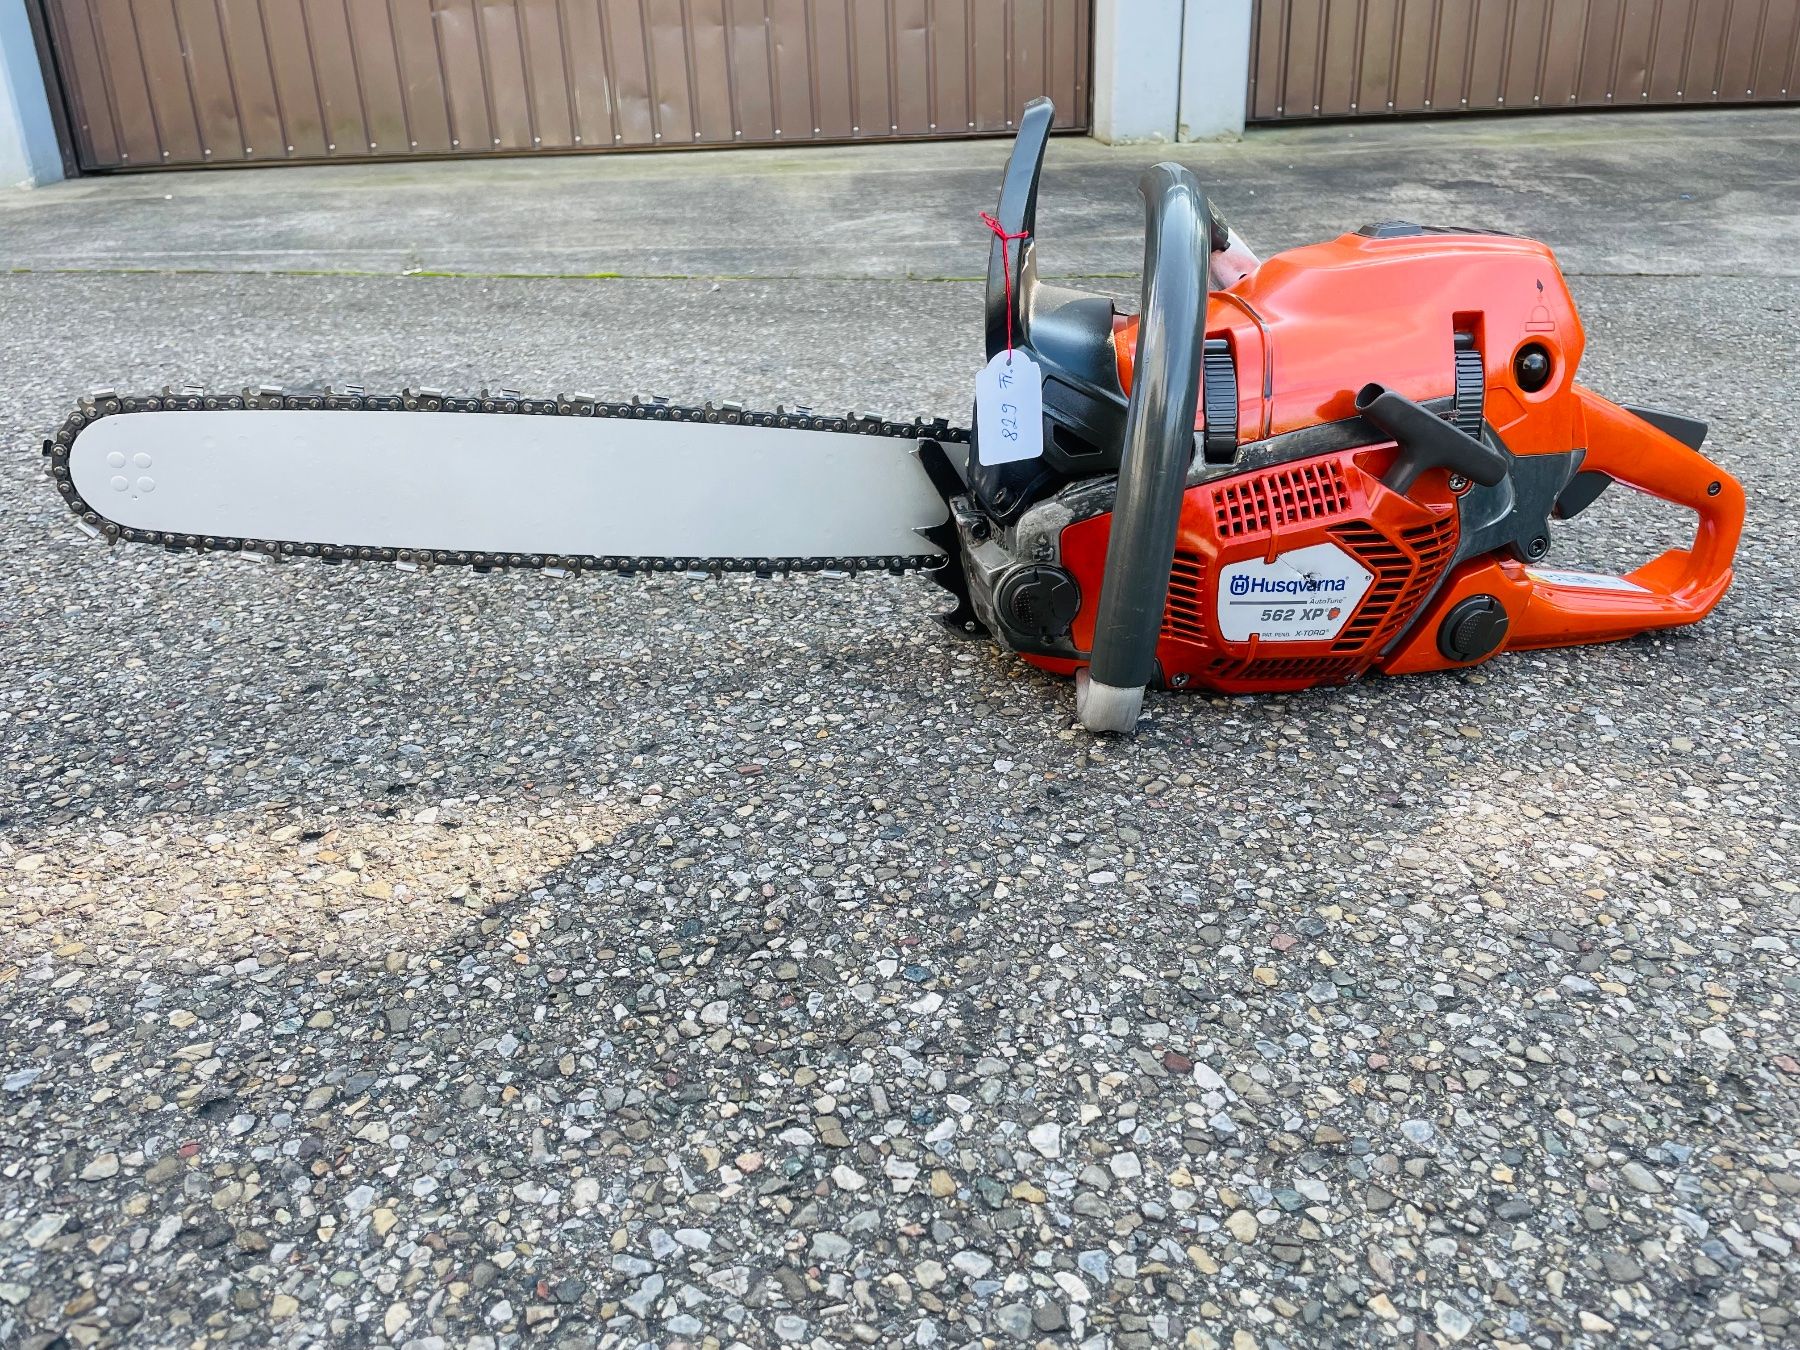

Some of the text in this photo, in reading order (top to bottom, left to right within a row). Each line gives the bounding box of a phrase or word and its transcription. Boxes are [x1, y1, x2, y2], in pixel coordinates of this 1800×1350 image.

[1001, 403, 1018, 441] 829
[1251, 577, 1346, 595] Husqvarna
[1260, 609, 1296, 622] 562
